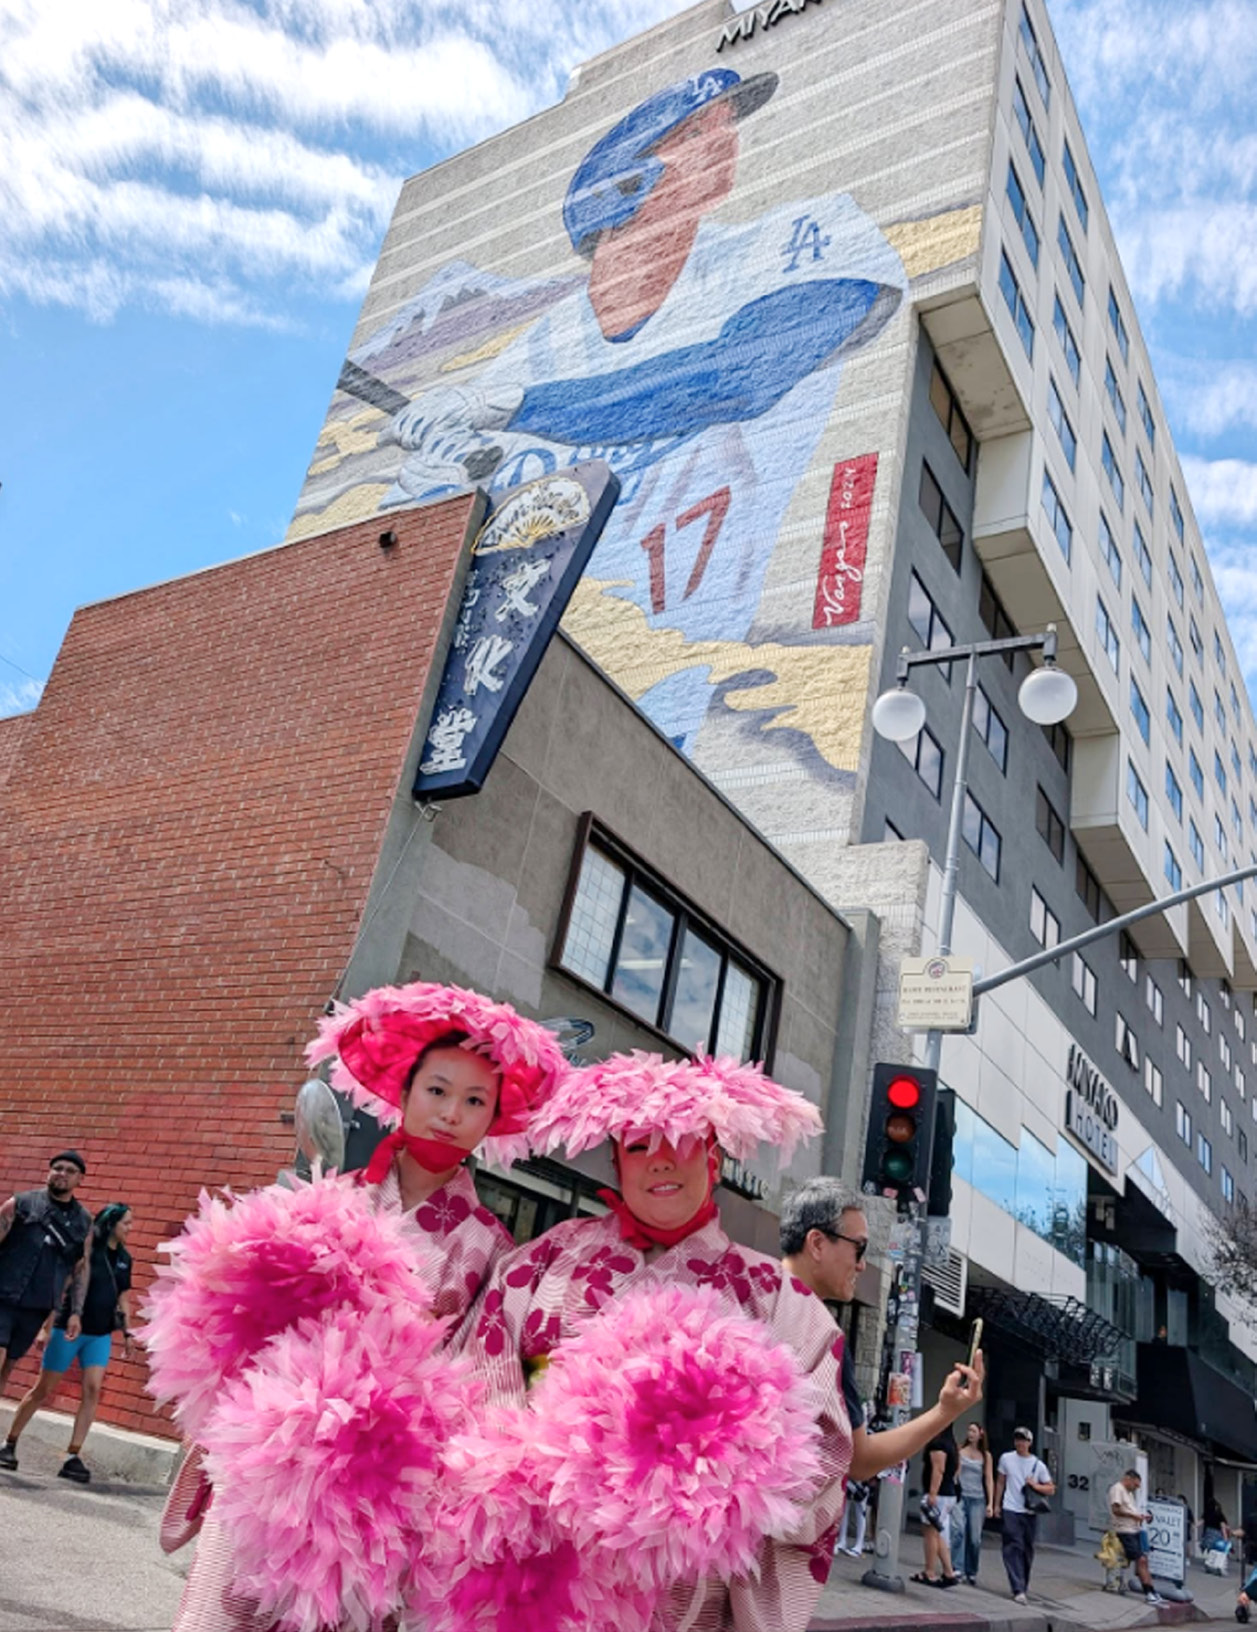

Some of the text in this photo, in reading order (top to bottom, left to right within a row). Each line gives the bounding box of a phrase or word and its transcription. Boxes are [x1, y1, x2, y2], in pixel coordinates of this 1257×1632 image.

[780, 214, 832, 274] LA
[640, 485, 732, 616] 17
[1068, 1474, 1089, 1492] 32
[1155, 1515, 1182, 1529] VALET
[1148, 1527, 1171, 1547] 20
